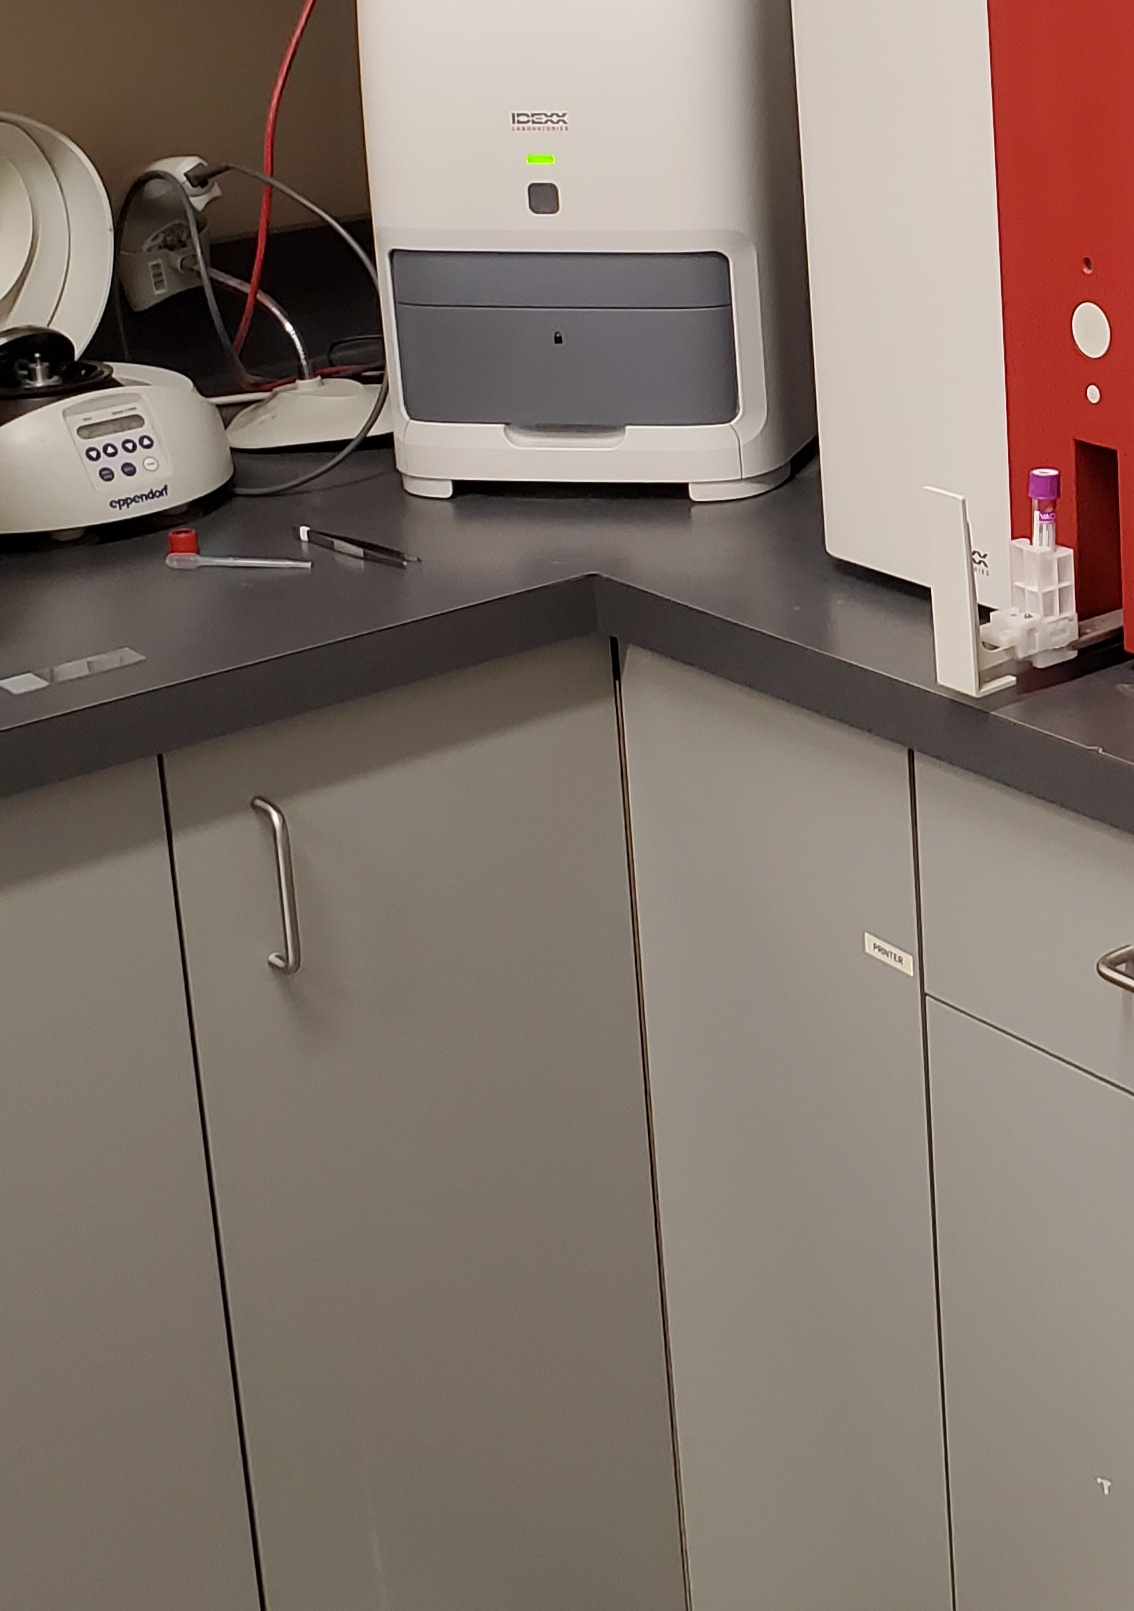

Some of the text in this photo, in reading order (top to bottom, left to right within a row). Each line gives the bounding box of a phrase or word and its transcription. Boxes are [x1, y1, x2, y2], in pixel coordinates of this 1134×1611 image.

[512, 113, 568, 125] IDEXX
[109, 484, 168, 510] eppendorf
[872, 942, 904, 965] PRINTER
